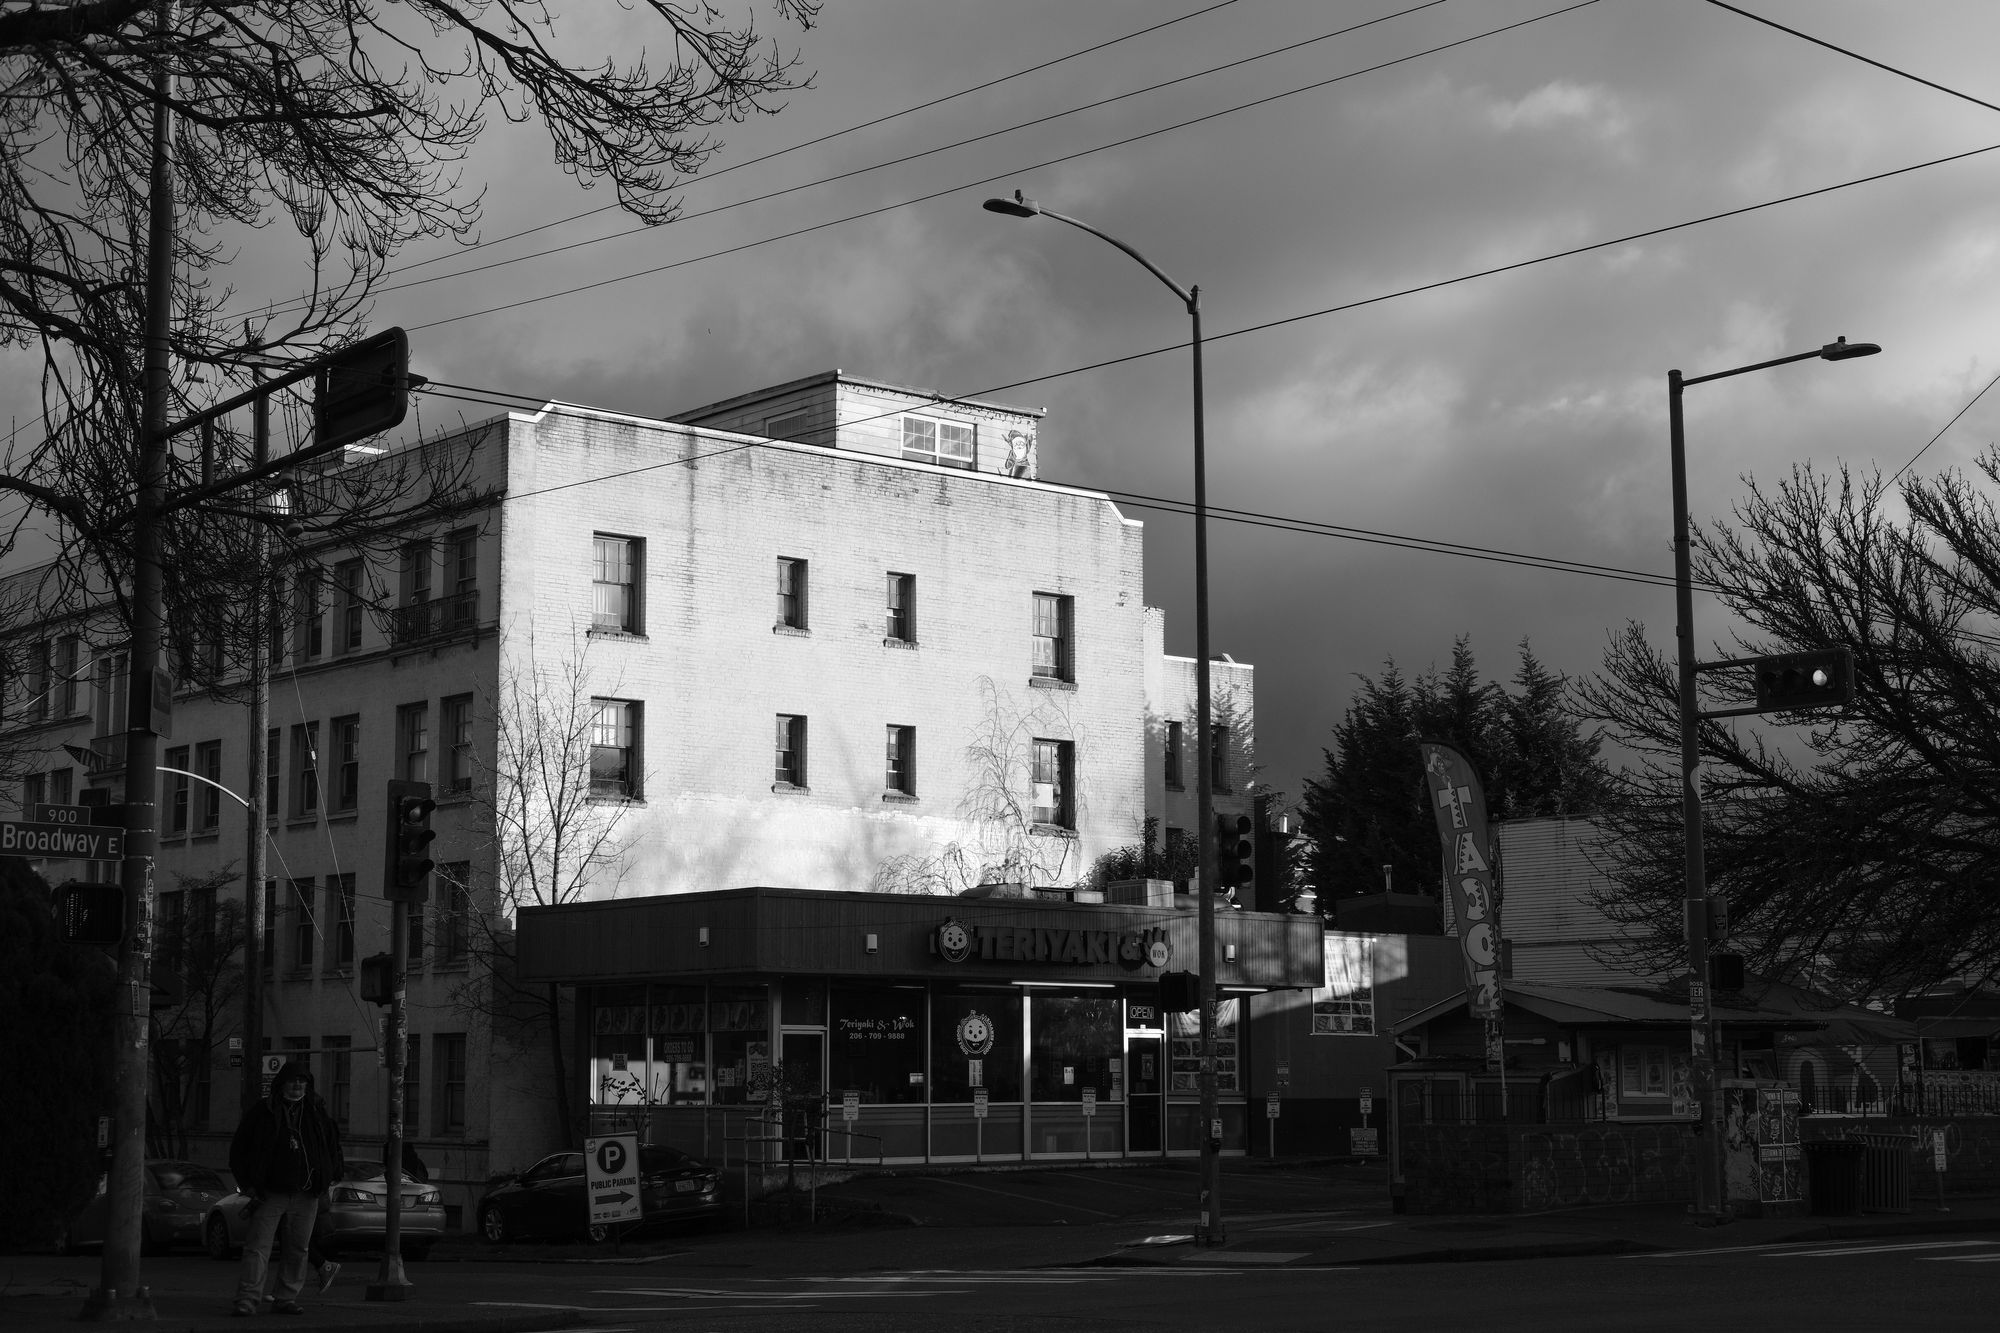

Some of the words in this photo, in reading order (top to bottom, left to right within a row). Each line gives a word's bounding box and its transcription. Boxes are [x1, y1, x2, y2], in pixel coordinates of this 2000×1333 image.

[48, 809, 77, 823] 900
[2, 823, 100, 857] Broadway
[108, 837, 118, 854] E
[978, 926, 1117, 963] TERIYAKI
[1131, 1007, 1153, 1018] OPEN
[840, 1018, 874, 1031] Teriyaki
[892, 1018, 915, 1031] Wok
[849, 1032, 863, 1040] 206
[869, 1032, 882, 1040] 709
[605, 1146, 620, 1169] P
[591, 1180, 612, 1190] PUBLIC
[612, 1176, 637, 1187] PARKING
